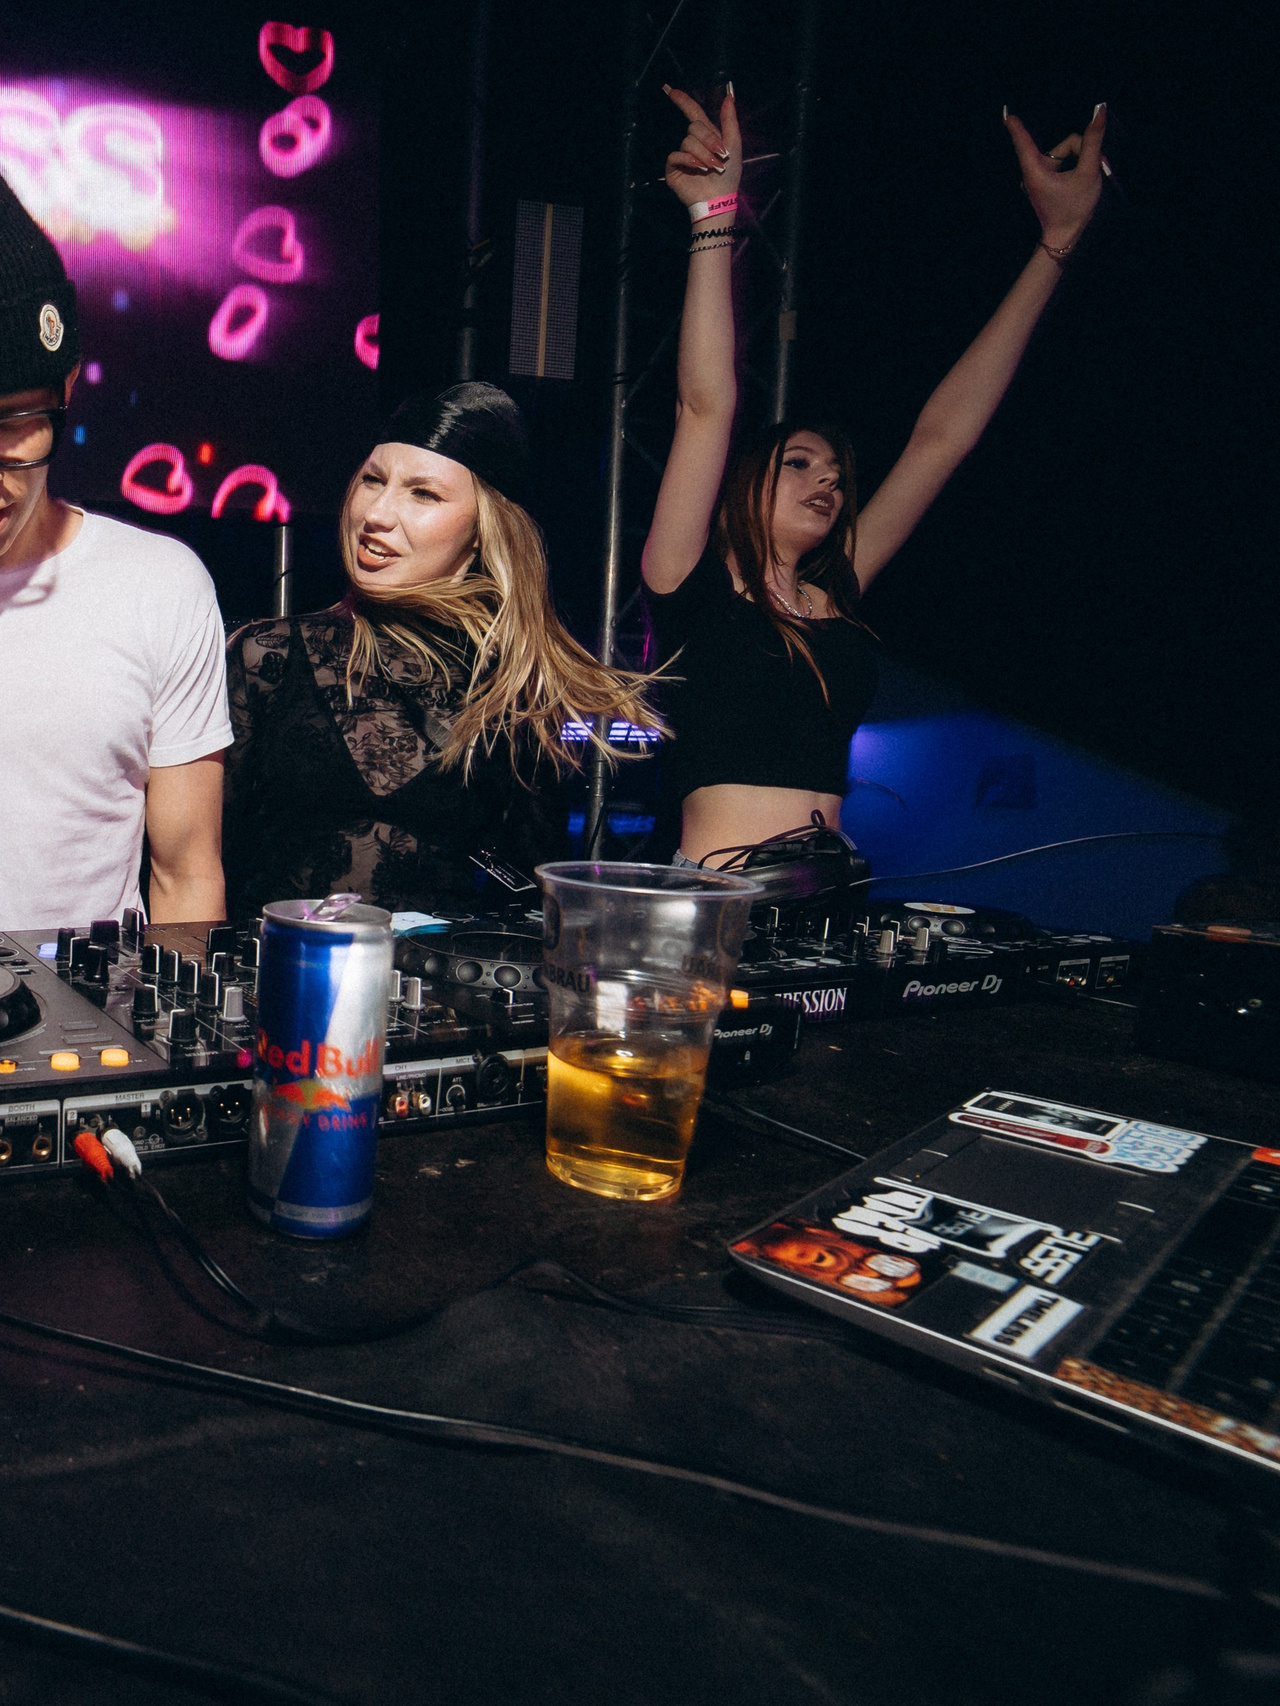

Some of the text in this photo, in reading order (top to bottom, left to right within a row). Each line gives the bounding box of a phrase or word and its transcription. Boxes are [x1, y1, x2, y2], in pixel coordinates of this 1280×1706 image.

[902, 979, 979, 999] Pioneer
[315, 1036, 380, 1078] Bull
[115, 1092, 145, 1101] MASTER
[8, 1103, 36, 1113] BOOTH
